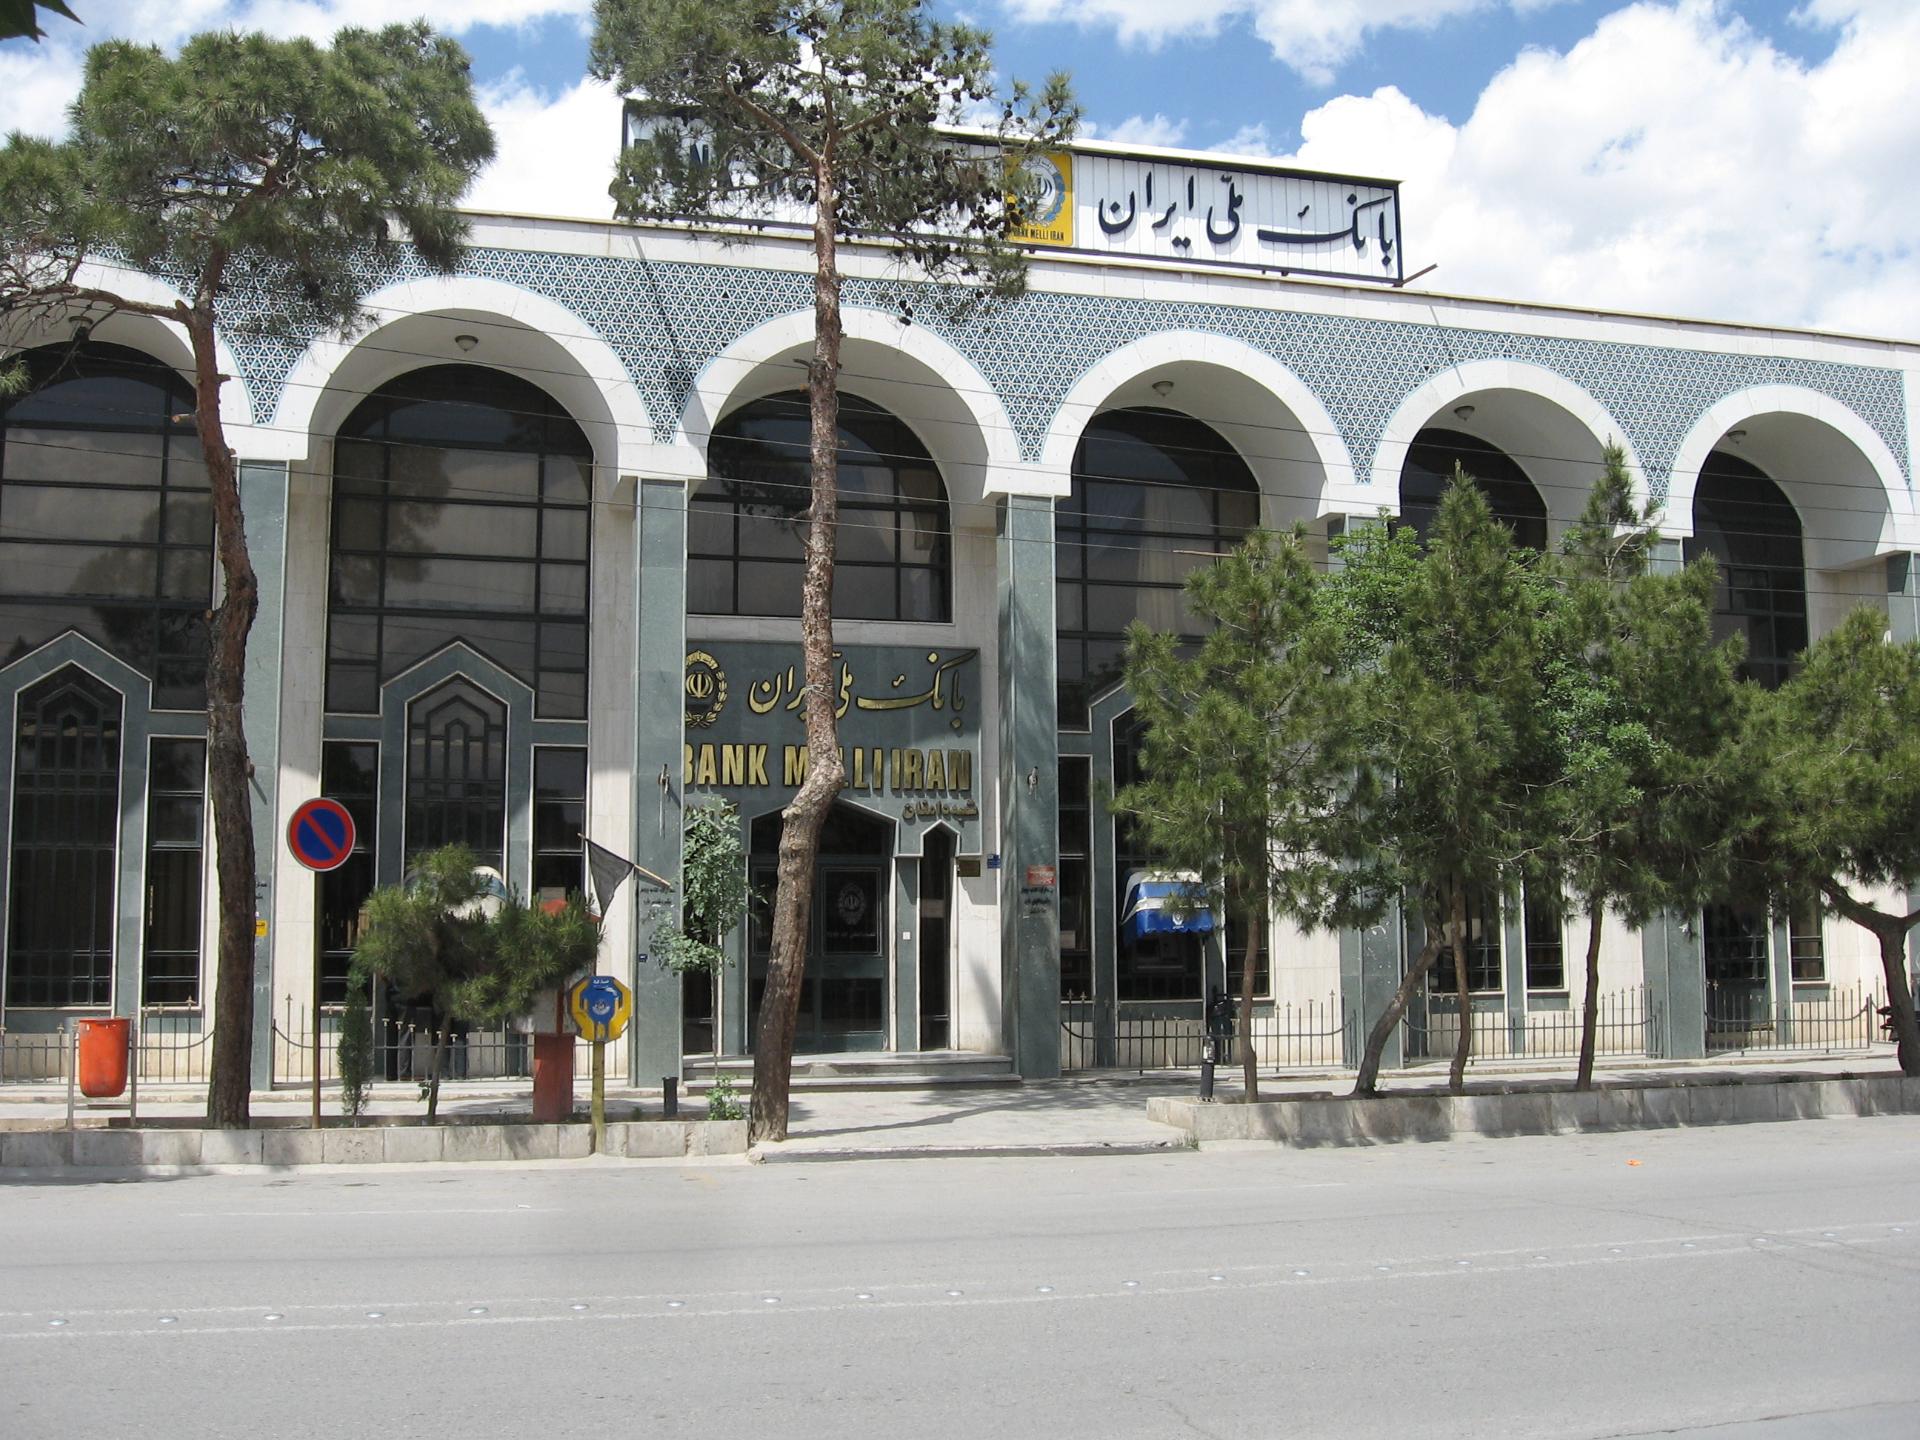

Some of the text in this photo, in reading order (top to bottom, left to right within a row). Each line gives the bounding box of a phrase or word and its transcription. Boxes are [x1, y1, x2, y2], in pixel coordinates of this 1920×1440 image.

[1031, 228, 1049, 239] MELLI
[1050, 230, 1065, 241] IRAN
[1099, 171, 1194, 249] ایران
[1257, 194, 1392, 265] بانک
[857, 650, 979, 729] بانک
[784, 745, 882, 789] MLI
[891, 748, 971, 790] IRAN
